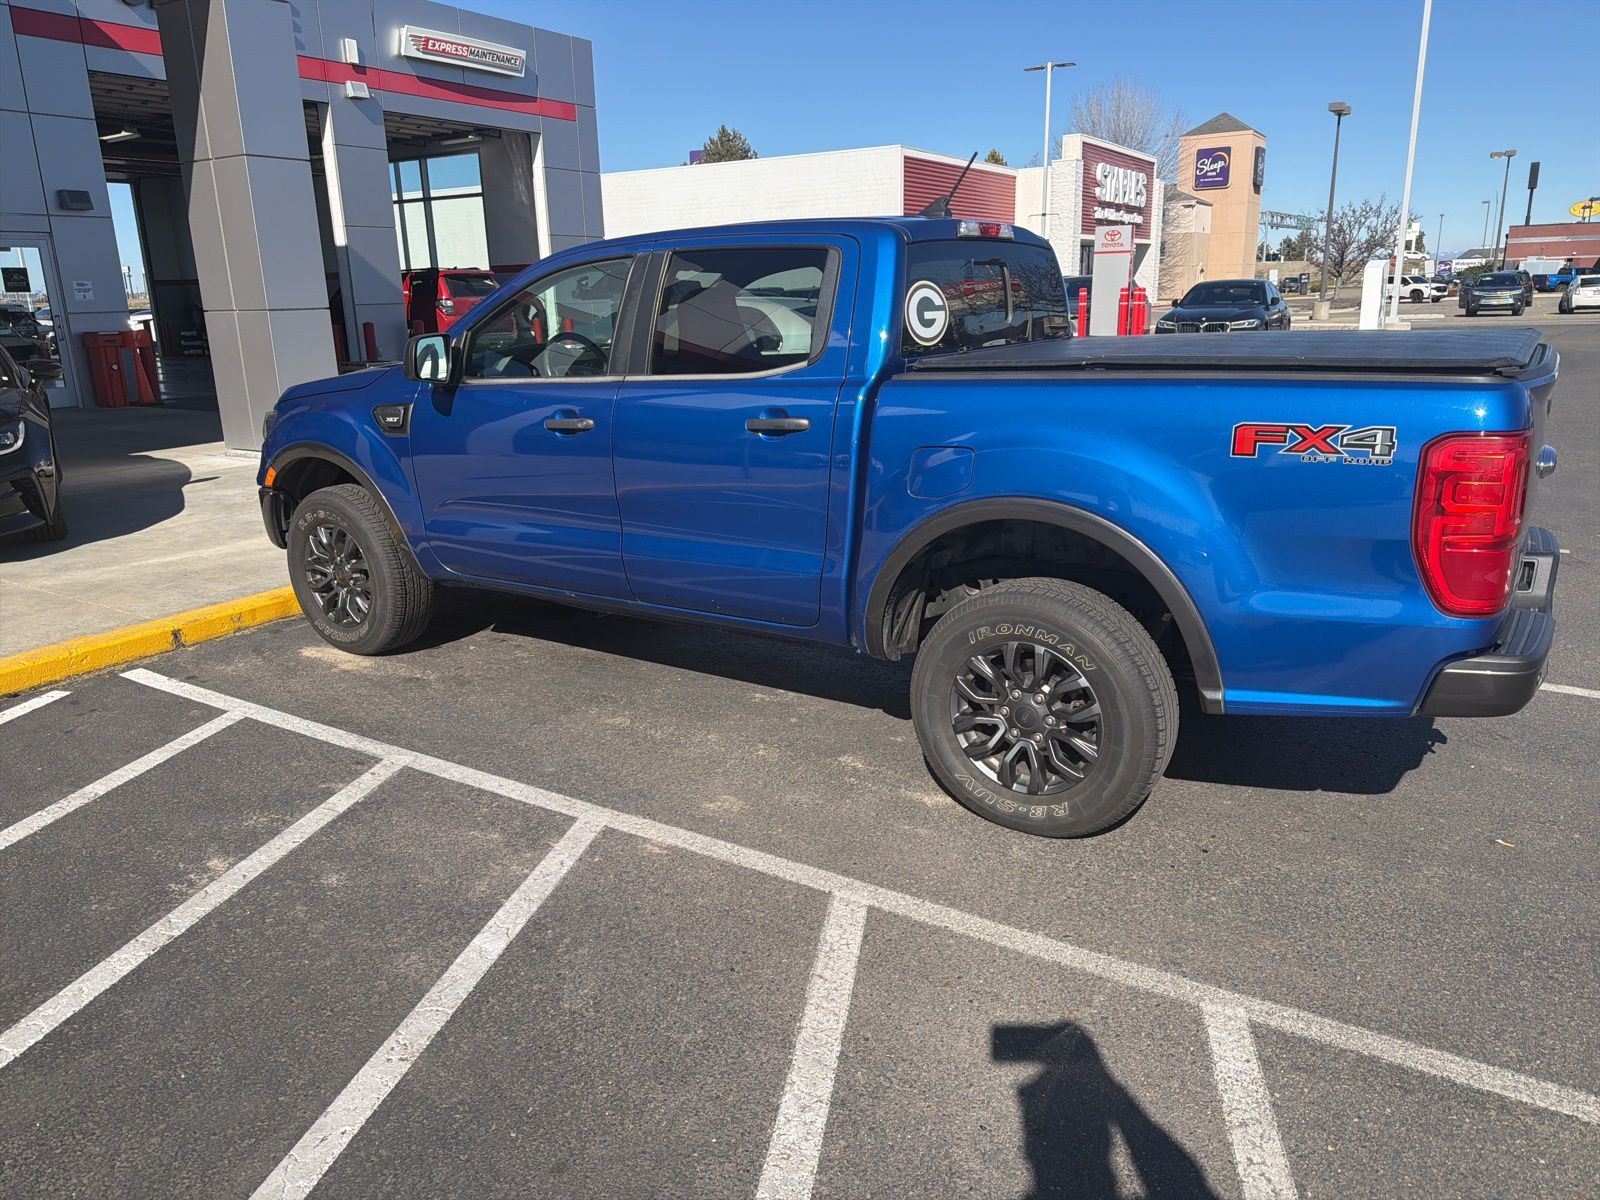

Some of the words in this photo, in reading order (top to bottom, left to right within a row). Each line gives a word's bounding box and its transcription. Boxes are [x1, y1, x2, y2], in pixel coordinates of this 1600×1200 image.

[427, 39, 468, 57] EXPRESS
[468, 48, 519, 67] MAINTENANCE
[1196, 157, 1226, 176] Sleep
[1094, 162, 1148, 208] STAPLES
[908, 287, 946, 339] G
[1230, 422, 1397, 458] FX4
[1301, 454, 1337, 463] OFF
[1342, 456, 1393, 467] ROAD
[968, 623, 1096, 671] IRONMAN
